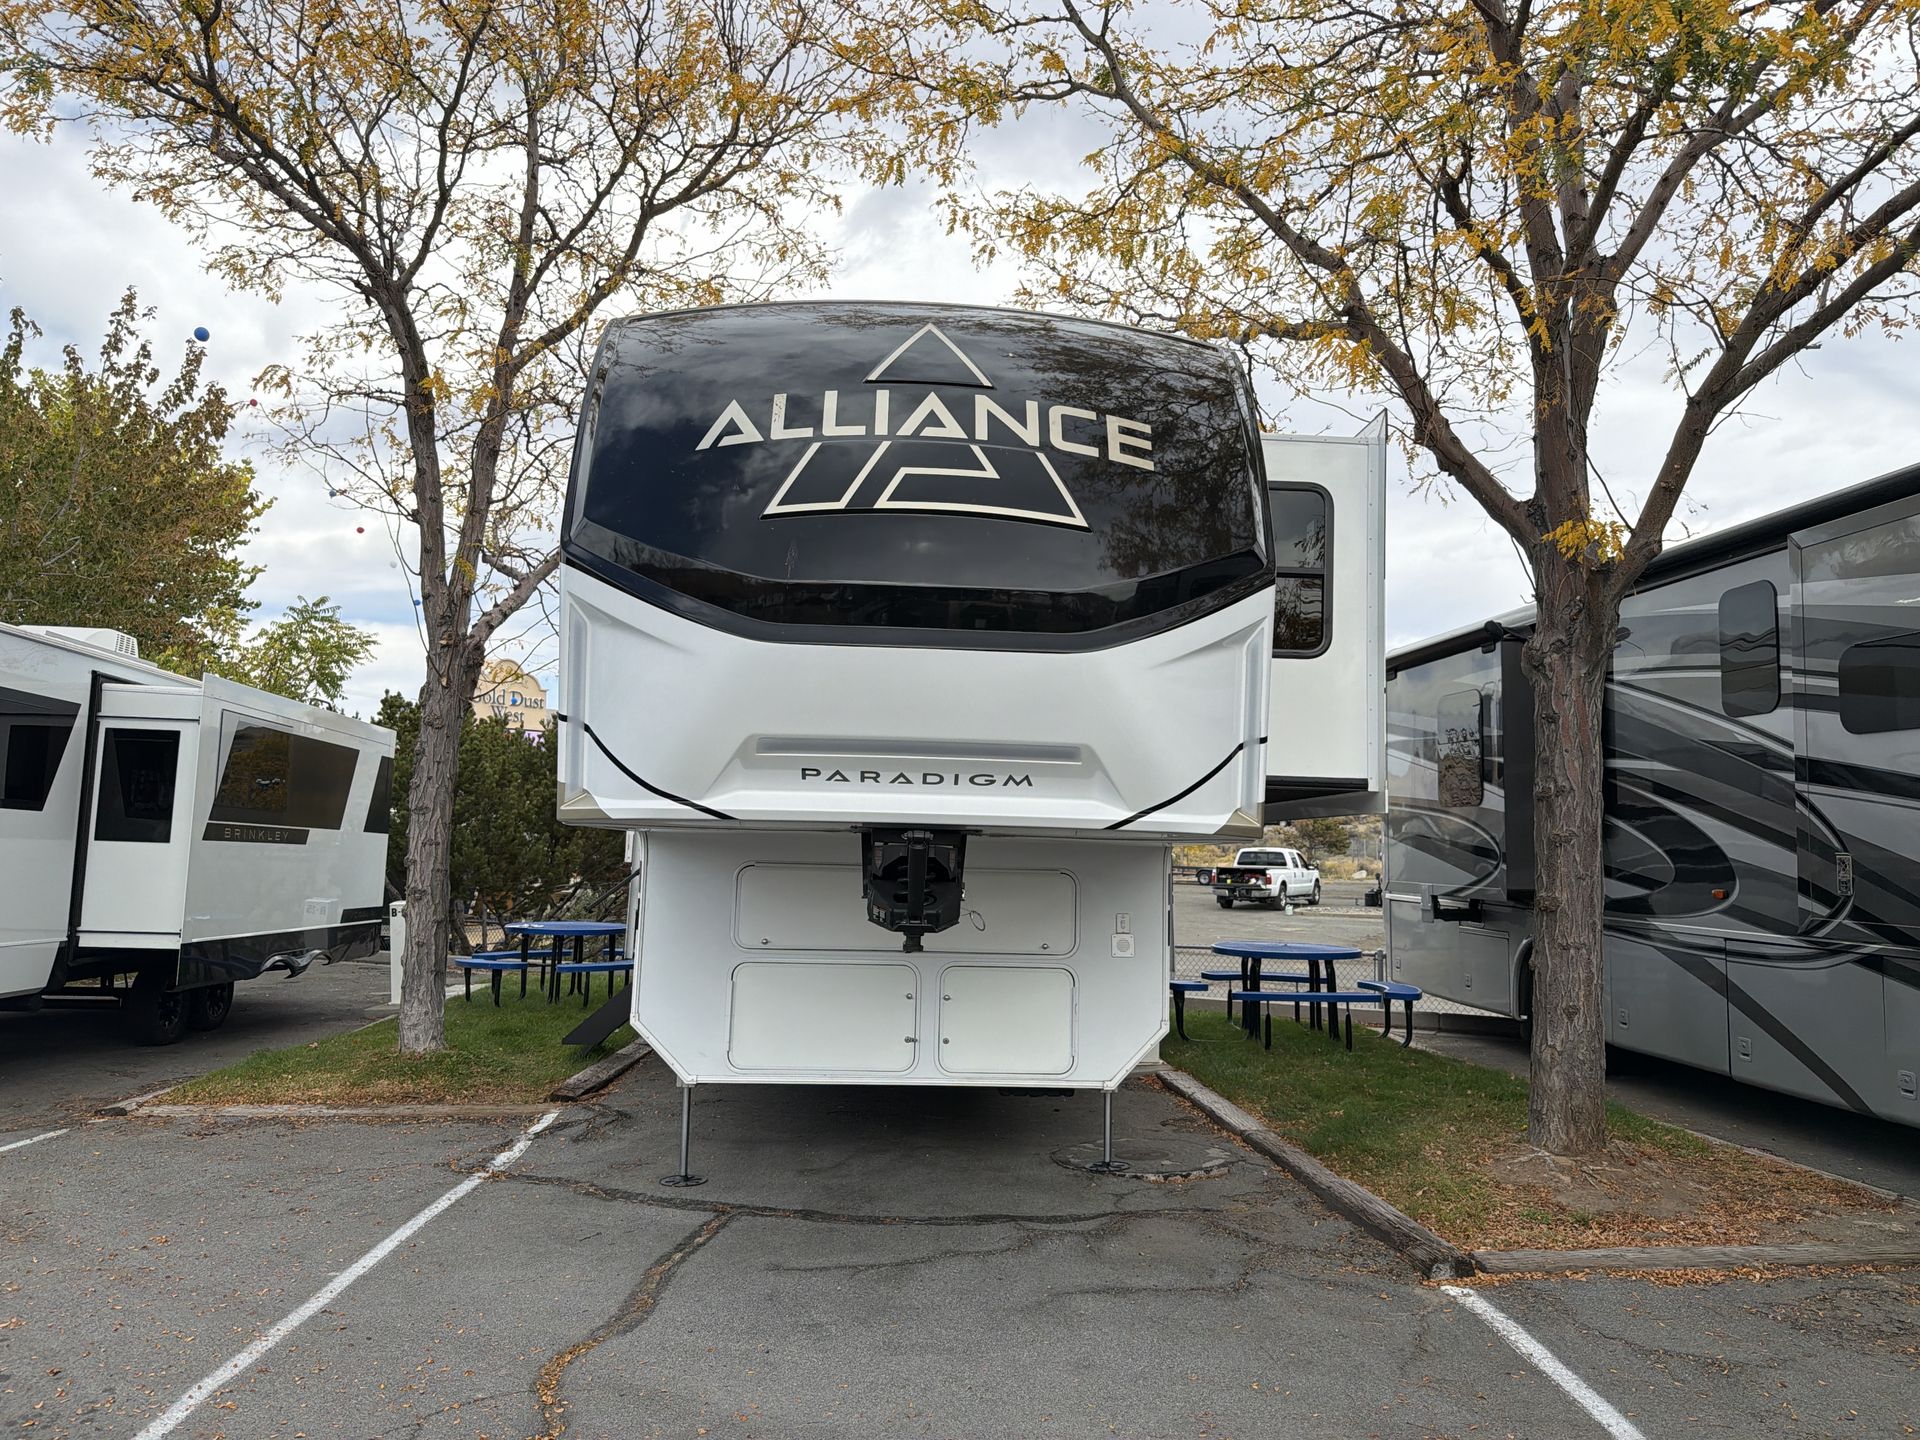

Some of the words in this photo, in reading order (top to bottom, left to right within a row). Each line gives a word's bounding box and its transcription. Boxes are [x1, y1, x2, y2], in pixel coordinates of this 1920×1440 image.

[694, 389, 1155, 472] ALLIANCE
[509, 690, 545, 710] Dust
[491, 704, 525, 723] West
[800, 767, 1034, 788] PARADIGM
[224, 827, 289, 841] BRINKLEY
[391, 907, 403, 918] B-
